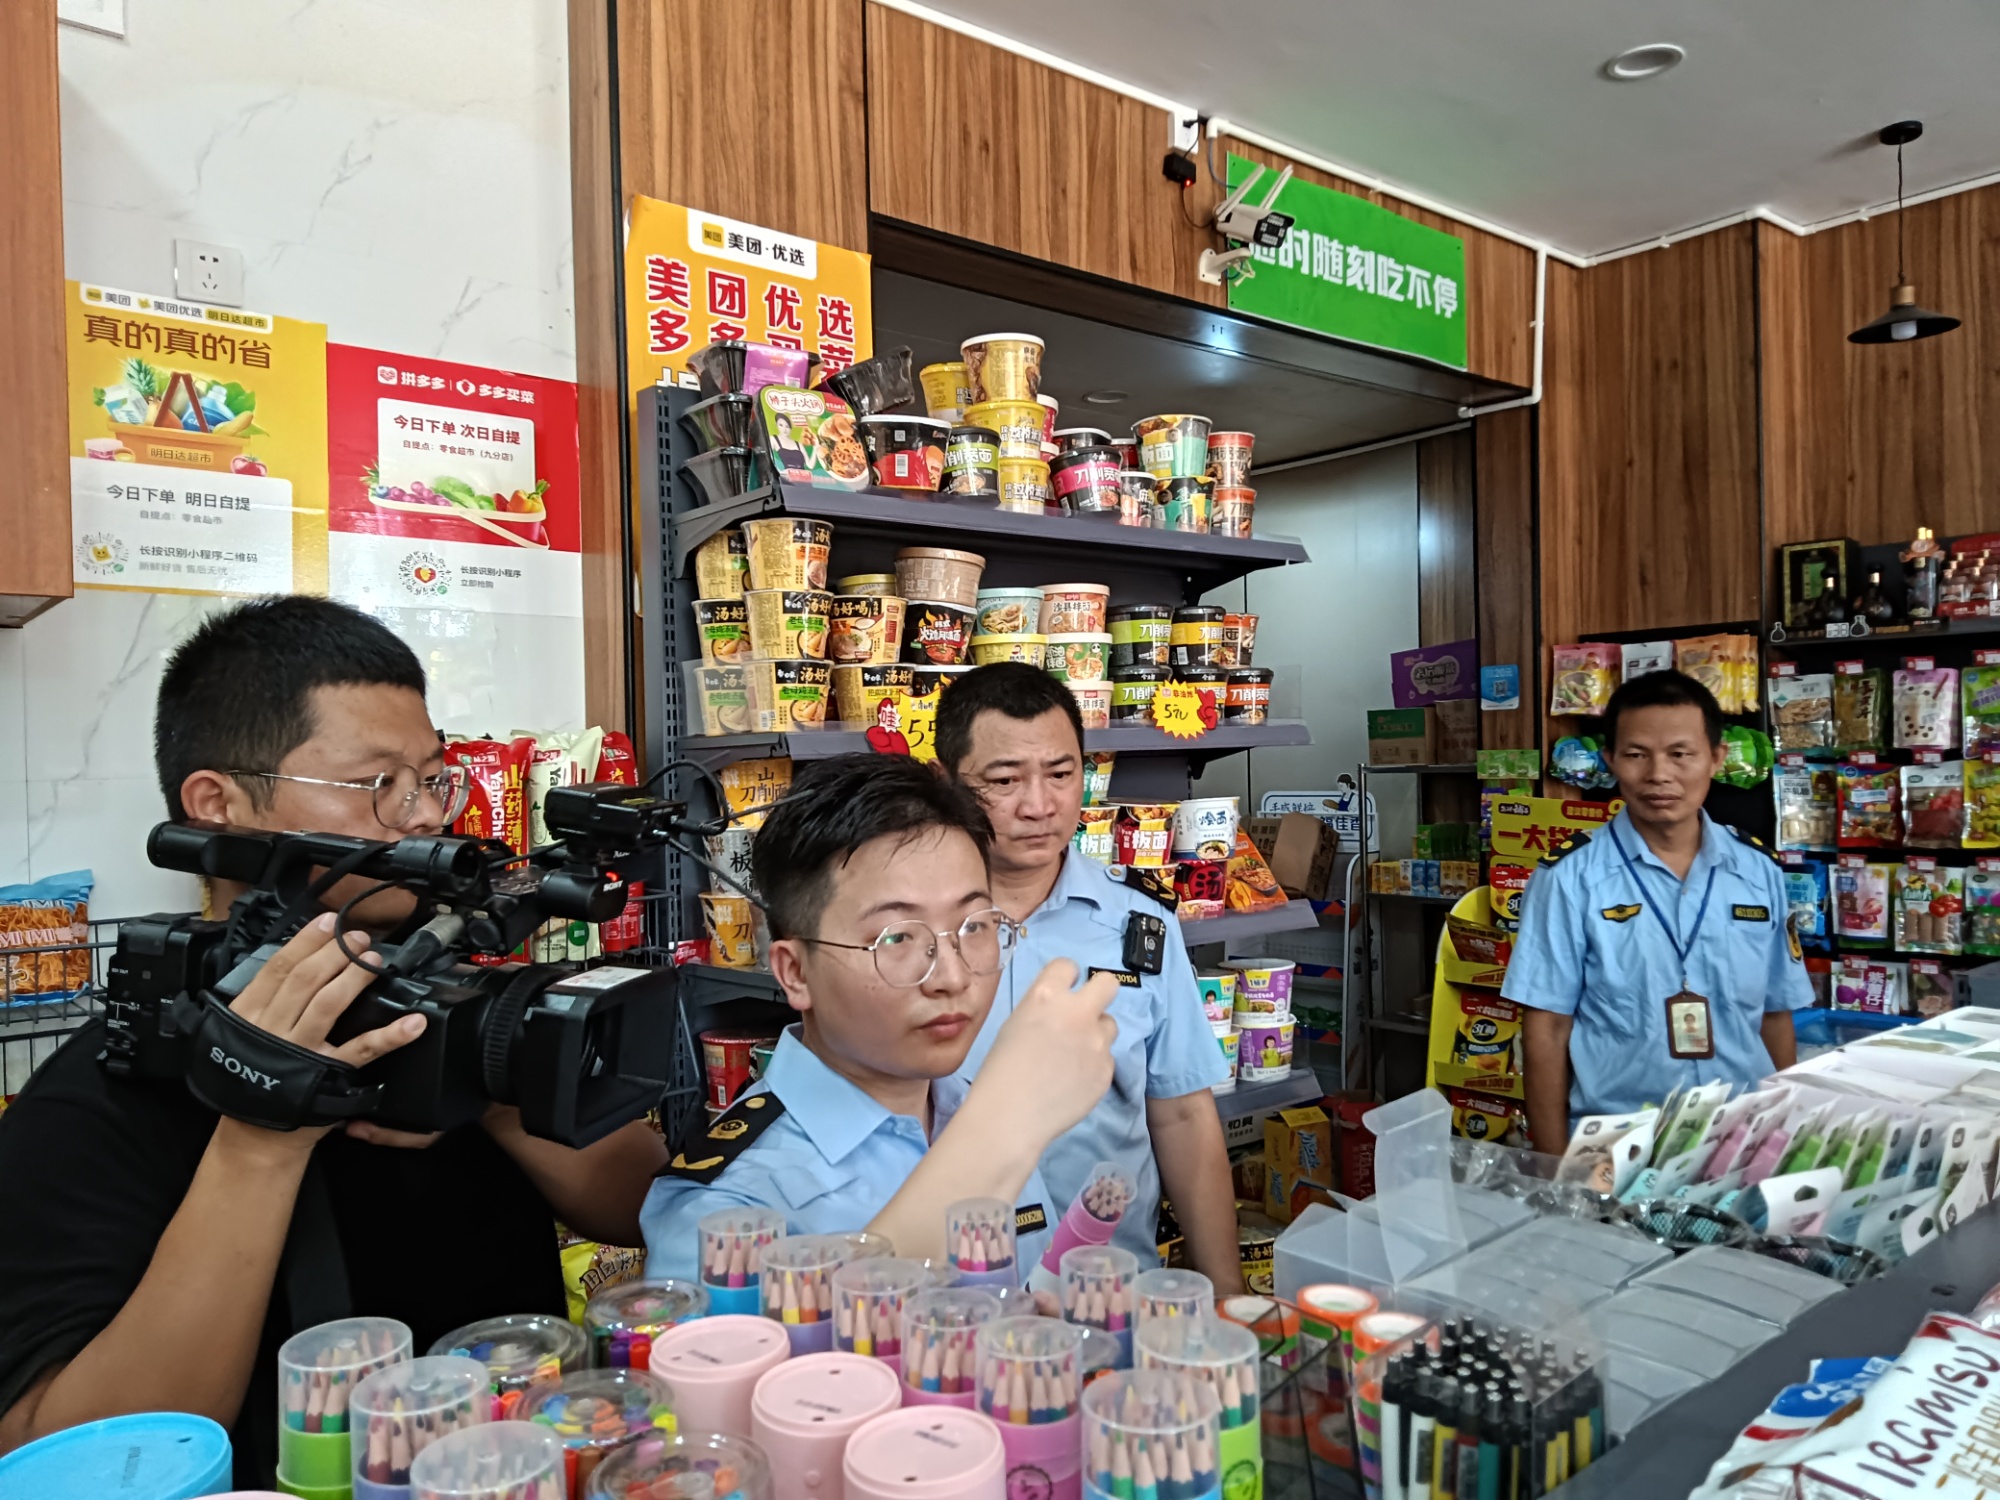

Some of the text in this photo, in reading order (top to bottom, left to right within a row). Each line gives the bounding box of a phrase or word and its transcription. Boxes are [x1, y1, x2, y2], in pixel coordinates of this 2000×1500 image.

[105, 292, 131, 307] 美团
[153, 300, 203, 319] 美团优选
[207, 310, 265, 328] 明日达超市
[83, 314, 272, 369] 真的真的省
[400, 371, 535, 405] 拼多多 多多买菜
[393, 414, 521, 445] 今日下单 次日自提
[150, 447, 212, 464] 明日达超市
[107, 484, 251, 512] 今日下单 明日自提
[139, 545, 258, 564] 长按识别小程序二维码
[460, 565, 522, 579] 长按识别小程序
[1498, 824, 1583, 853] 一大袋
[209, 1046, 281, 1091] SONY
